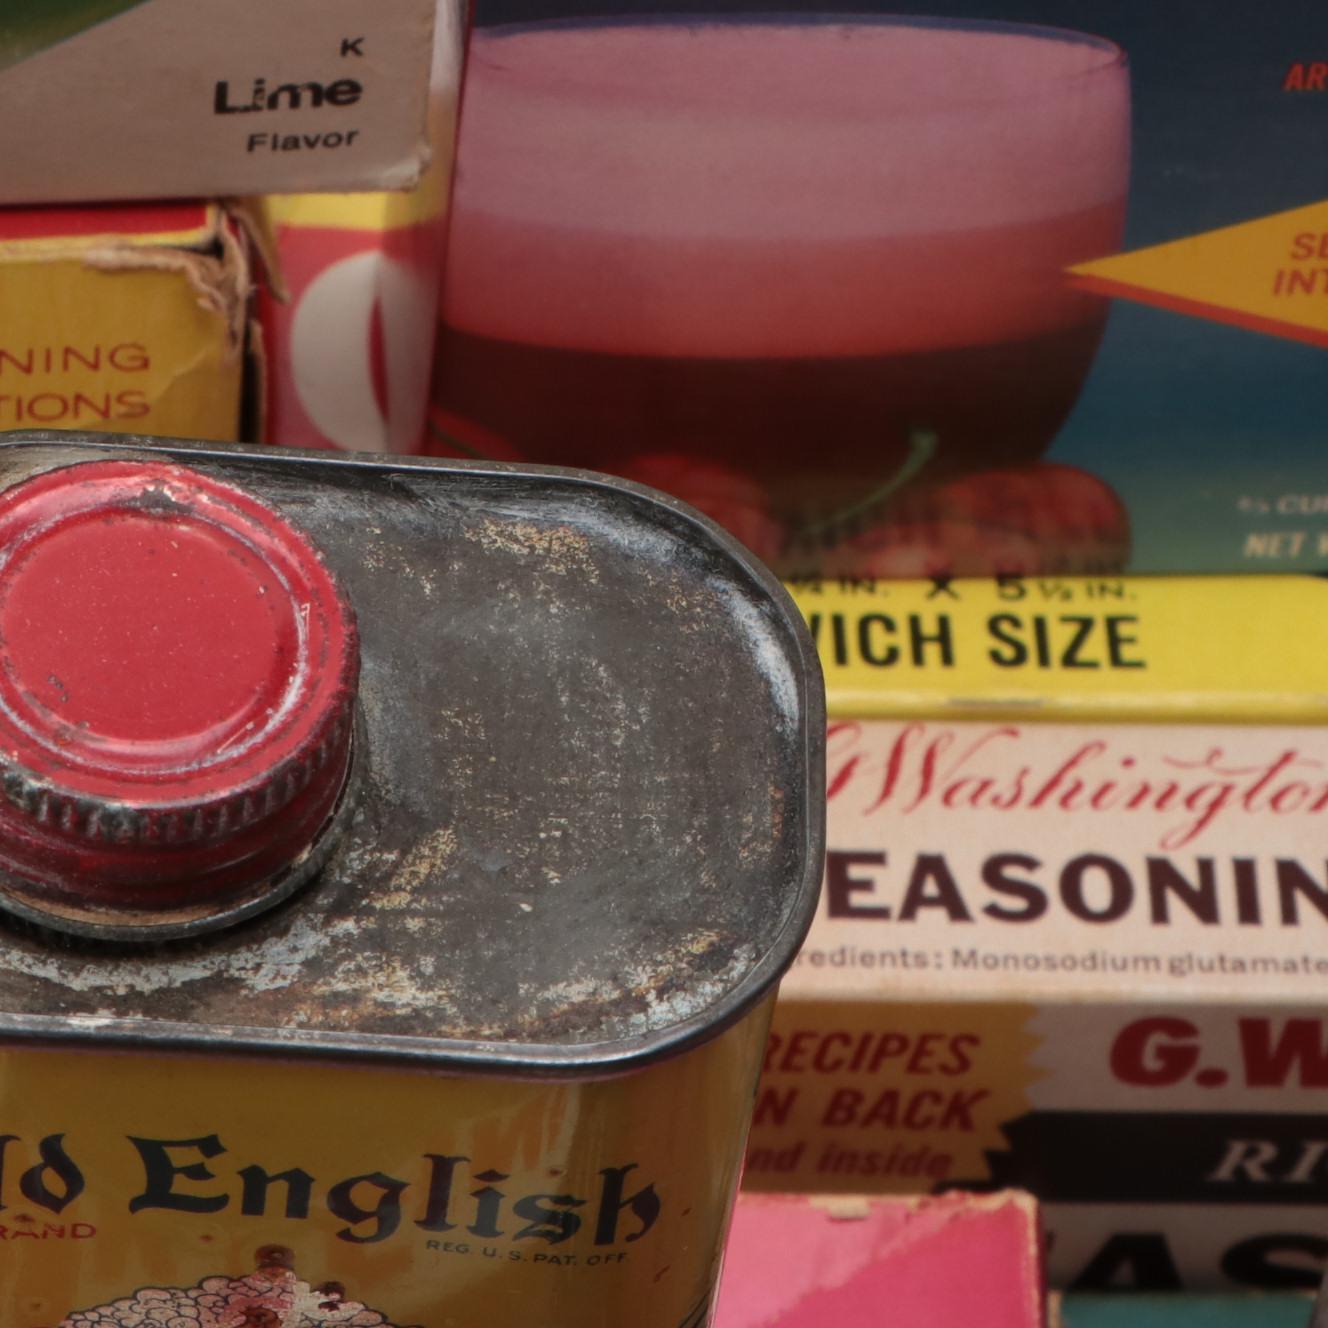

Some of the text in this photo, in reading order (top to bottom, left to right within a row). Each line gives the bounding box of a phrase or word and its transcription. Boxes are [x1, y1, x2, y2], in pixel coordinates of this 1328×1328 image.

[340, 37, 365, 57] K
[213, 78, 364, 115] Lime
[246, 129, 359, 152] Flavor
[1243, 530, 1304, 558] NET
[812, 613, 1147, 670] ICH SIZE
[951, 947, 1161, 973] Monosodium
[751, 1086, 992, 1133] N BACK
[746, 1140, 954, 1180] nd inside
[126, 1133, 662, 1247] English
